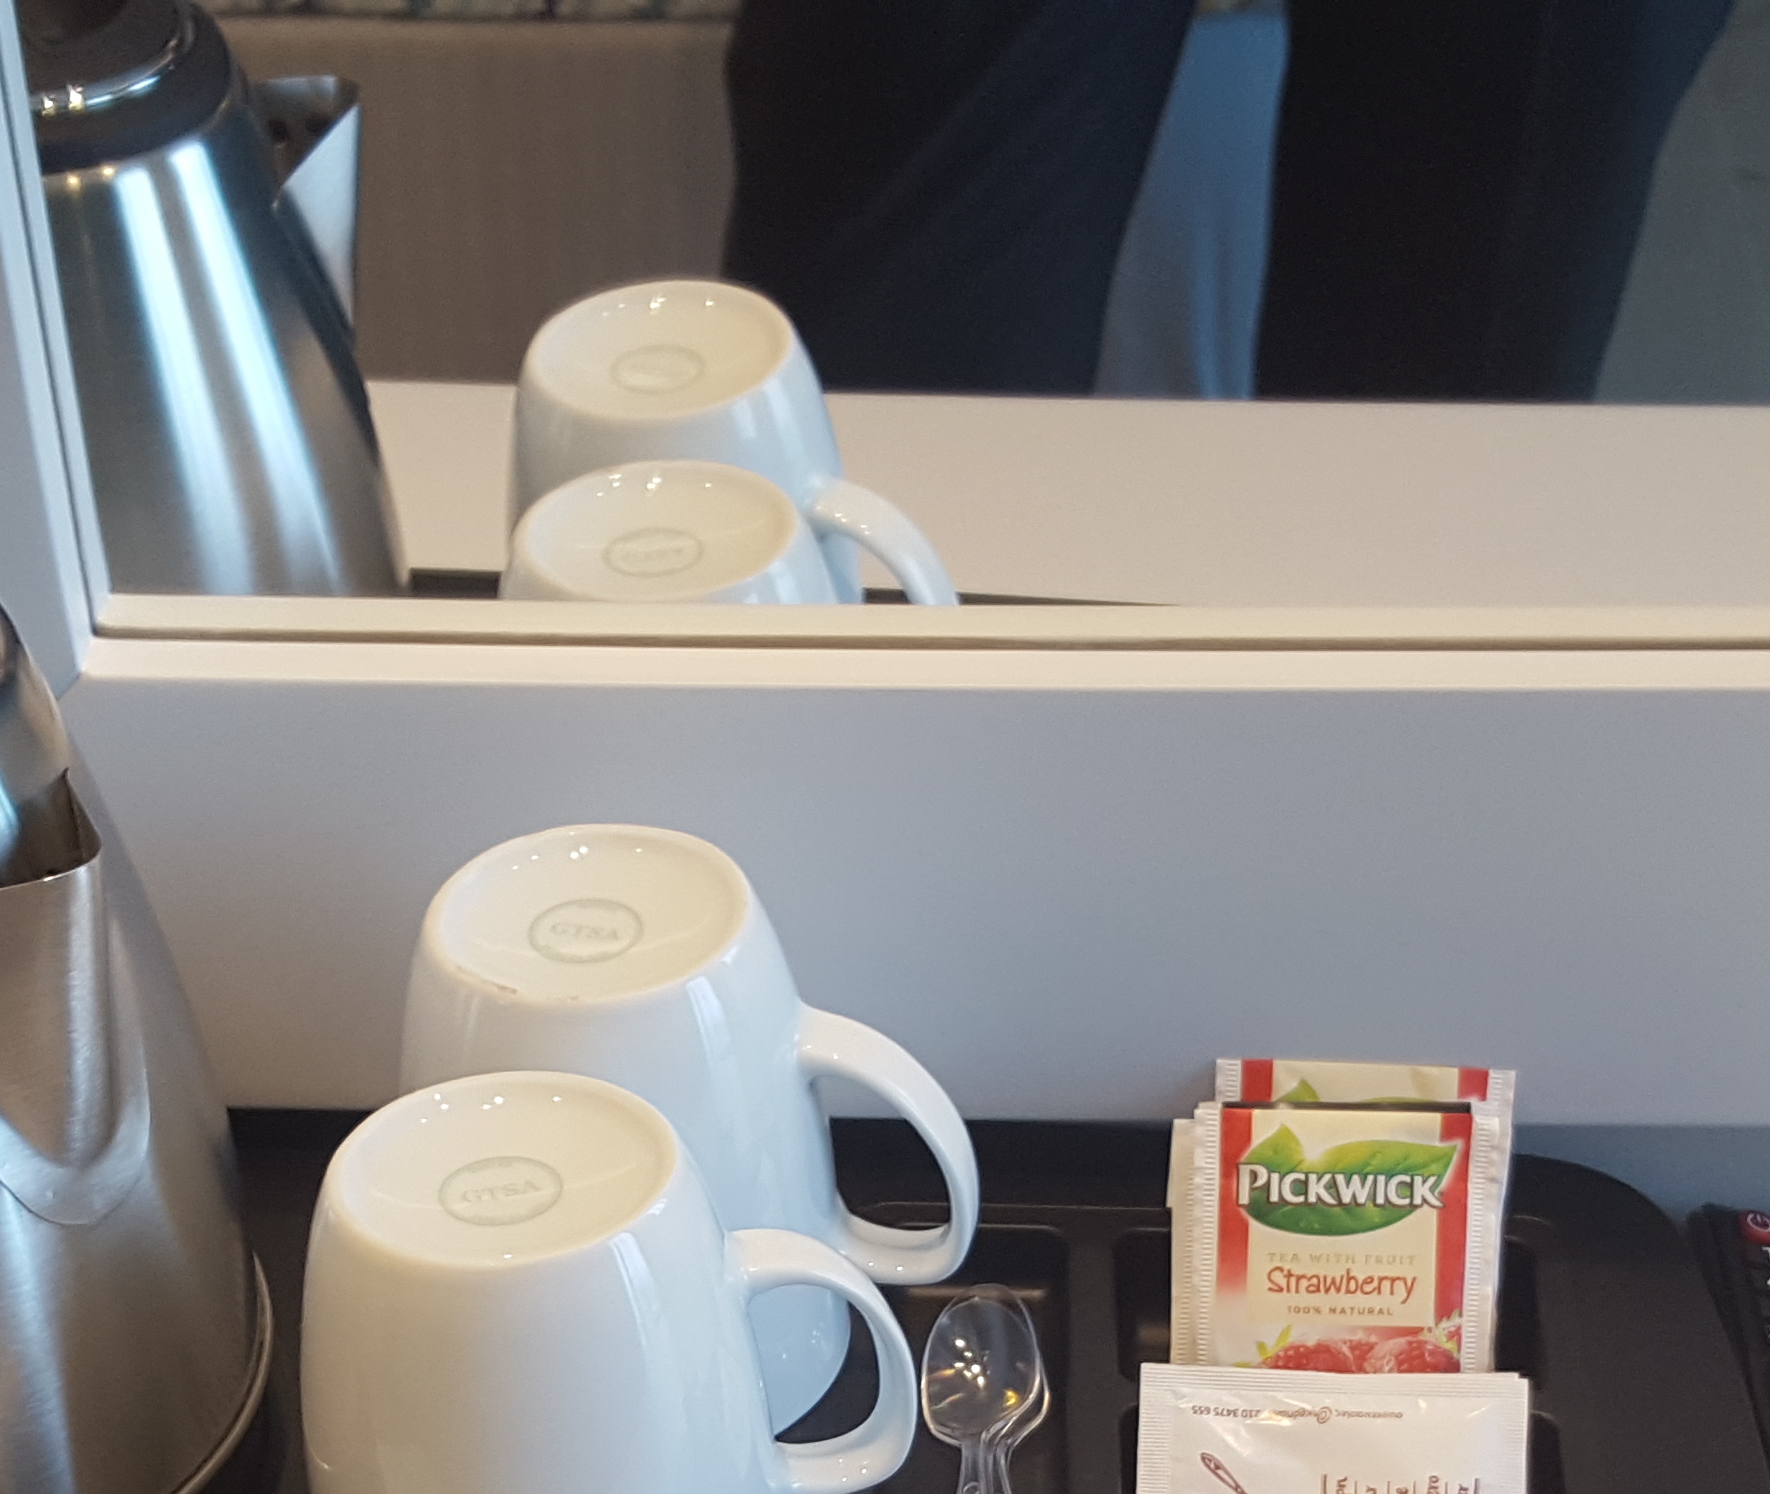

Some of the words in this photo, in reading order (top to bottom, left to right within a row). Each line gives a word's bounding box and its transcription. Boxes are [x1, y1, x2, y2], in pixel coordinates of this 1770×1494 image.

[1236, 1161, 1446, 1208] PICKWICK
[1267, 1253, 1300, 1263] TEA
[1309, 1253, 1355, 1265] WITH
[1364, 1253, 1417, 1265] FRUIT
[1266, 1266, 1417, 1304] Strawberry
[1287, 1305, 1322, 1315] 100%
[1328, 1306, 1395, 1316] NATURAL
